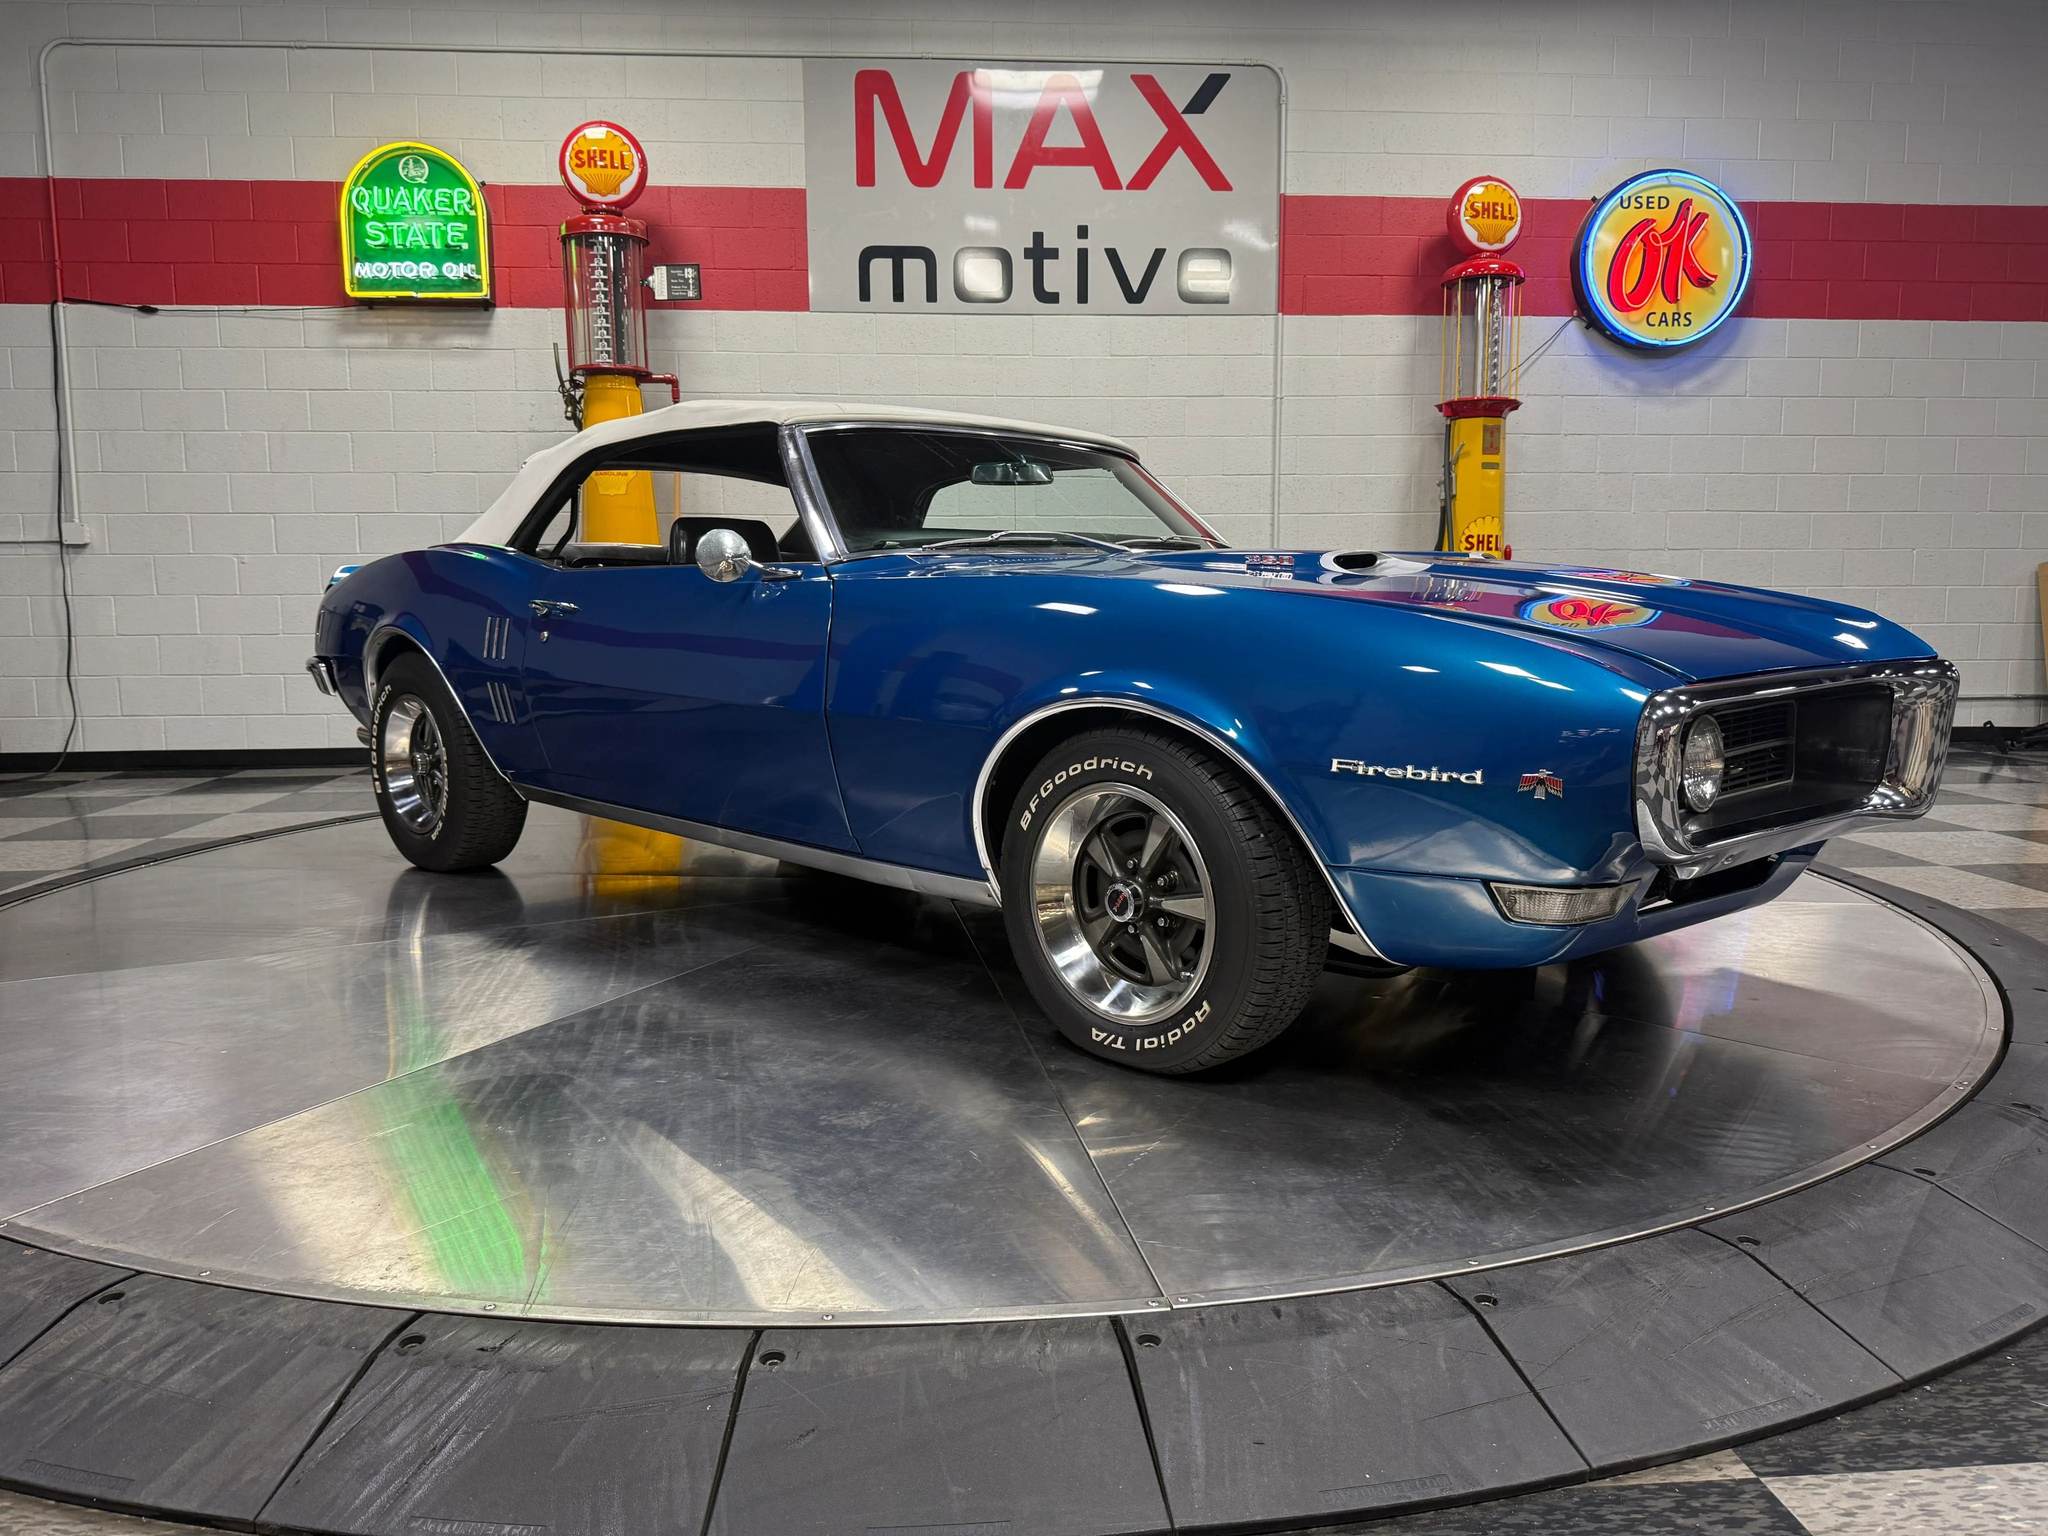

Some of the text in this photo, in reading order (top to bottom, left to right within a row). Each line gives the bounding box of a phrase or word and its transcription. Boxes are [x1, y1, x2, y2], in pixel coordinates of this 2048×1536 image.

[854, 68, 1234, 191] MAX
[574, 149, 630, 171] SHELL
[351, 186, 476, 218] QUAKER
[1469, 201, 1515, 221] SHELL
[1620, 196, 1670, 210] USED
[365, 221, 469, 249] STATE
[858, 225, 1233, 305] motive
[1606, 197, 1718, 313] OK
[354, 261, 482, 280] MOTOR OIL
[1646, 312, 1693, 327] CARS
[1329, 757, 1485, 786] Firebird
[1020, 756, 1153, 831] BFGoodrich
[1091, 1000, 1211, 1051] Radial T/A
